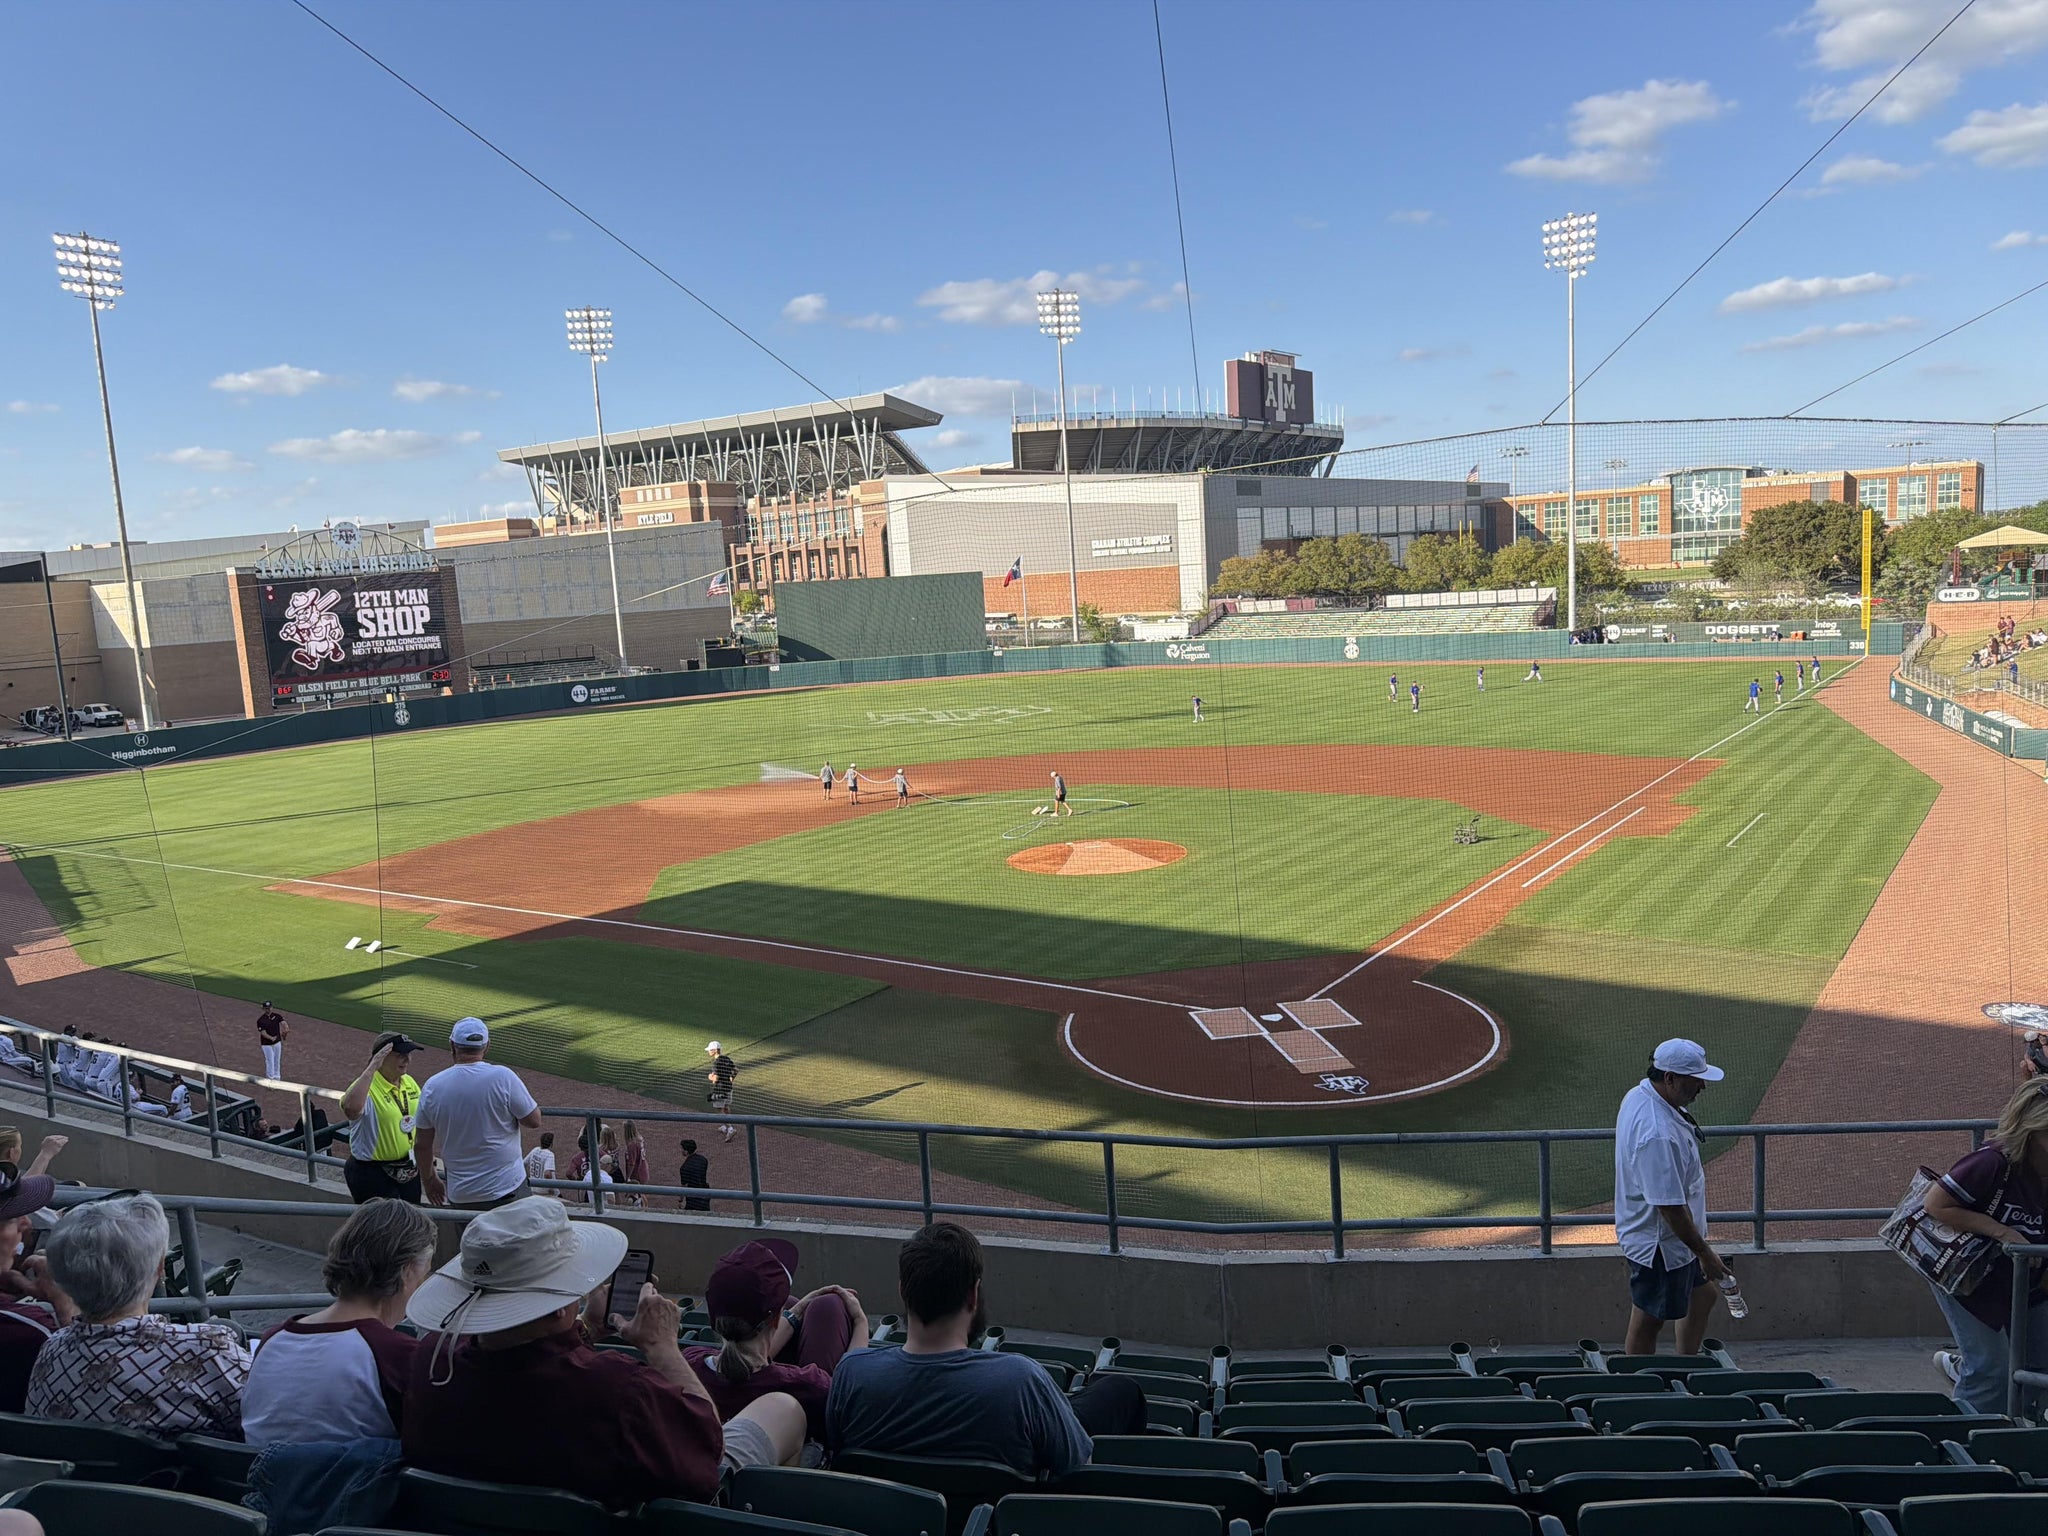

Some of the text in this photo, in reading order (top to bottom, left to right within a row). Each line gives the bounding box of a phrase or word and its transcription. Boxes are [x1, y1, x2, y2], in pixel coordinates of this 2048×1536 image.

[255, 553, 438, 578] TEXAS A&M BASEBALL
[353, 588, 429, 608] 12TH MAN
[356, 605, 431, 638] SHOP
[1705, 624, 1781, 635] DOGGETT
[352, 635, 441, 649] LOCATED ON CONCOURSE
[352, 648, 372, 656] NEXT
[383, 645, 404, 653] MAIN
[405, 641, 442, 652] ENTRANCE
[1181, 651, 1210, 661] Ferguson
[298, 672, 422, 693] OLSEN FIELD AT BLUE BELL PARK
[332, 692, 347, 700] JOHN
[590, 686, 616, 695] FARMS
[112, 745, 177, 760] Higginbotham
[2004, 1203, 2042, 1225] Texas
[1933, 1247, 1955, 1274] HOWDY
